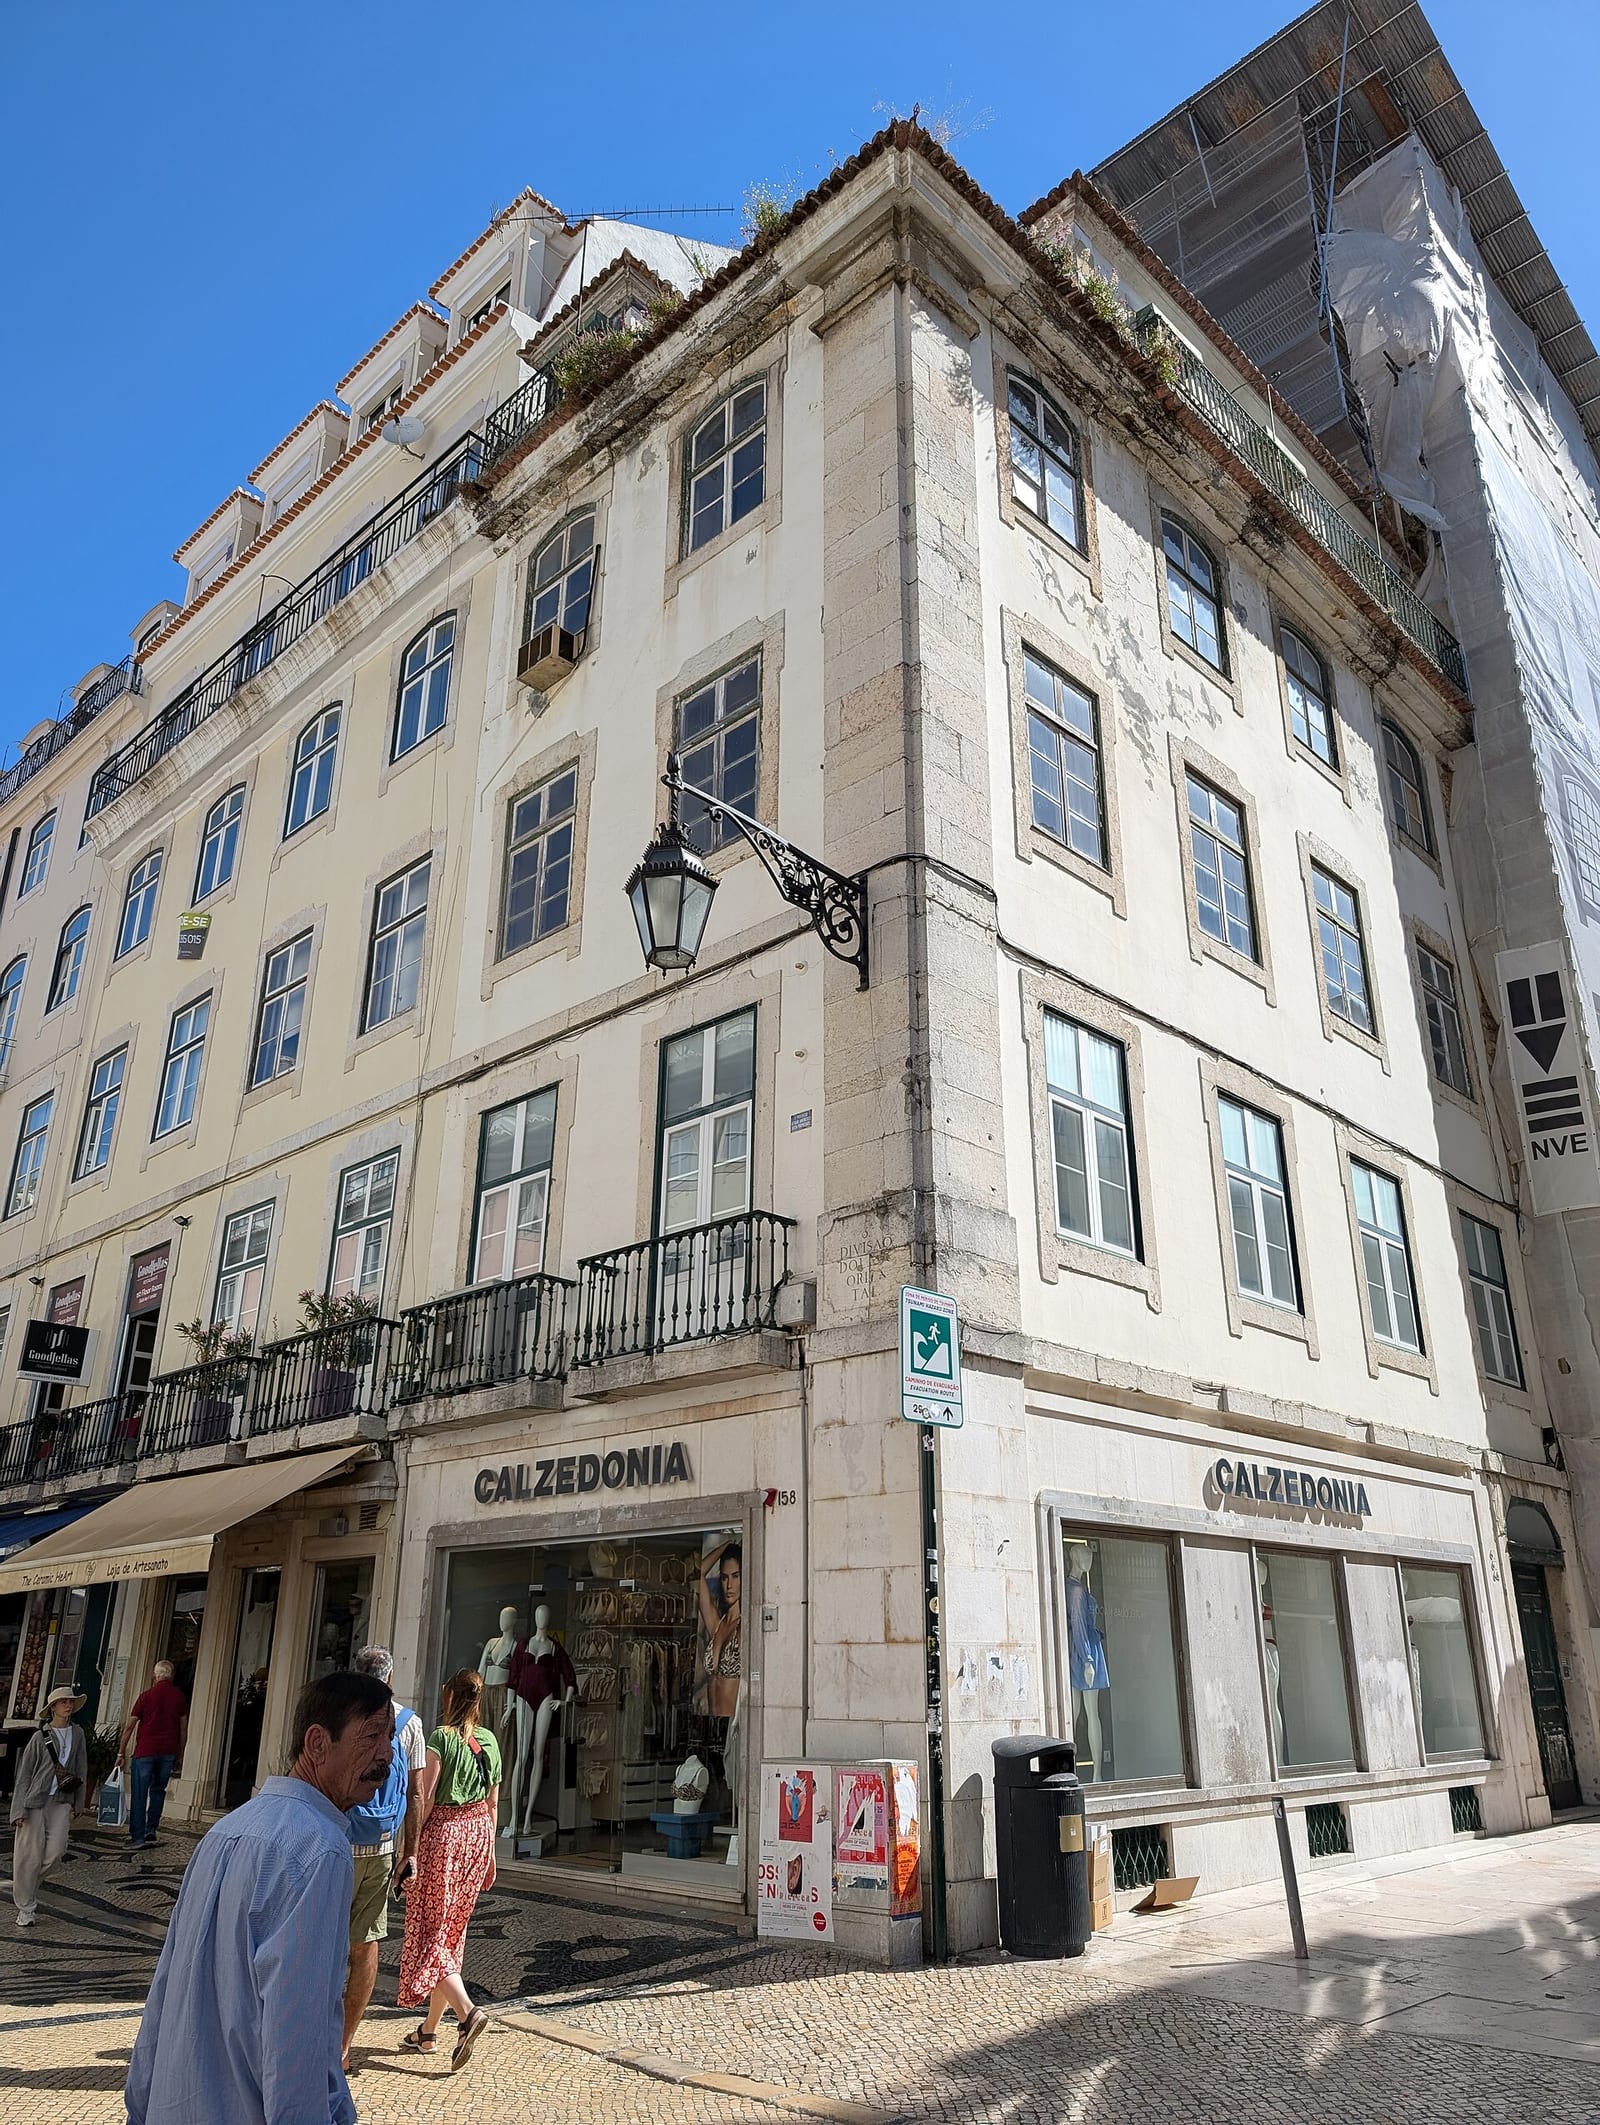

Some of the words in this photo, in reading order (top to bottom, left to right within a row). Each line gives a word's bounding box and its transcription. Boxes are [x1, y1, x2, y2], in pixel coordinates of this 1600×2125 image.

[1531, 1132, 1589, 1161] NVE
[905, 1297, 925, 1308] TSUNAMI
[28, 1349, 79, 1365] Goodfellas
[905, 1376, 926, 1387] CAMINHO
[926, 1379, 933, 1387] DE
[910, 1384, 939, 1394] EVACUATION
[939, 1387, 955, 1398] ROUTE
[474, 1441, 692, 1504] CALZEDONIA
[1212, 1457, 1373, 1517] CALZEDONIA
[777, 1490, 797, 1506] 158
[106, 1563, 121, 1579] Loja
[122, 1563, 131, 1575] de
[132, 1558, 169, 1574] Artesanato
[21, 1575, 32, 1587] The
[33, 1573, 54, 1586] Ceramic
[55, 1570, 74, 1583] HeArt
